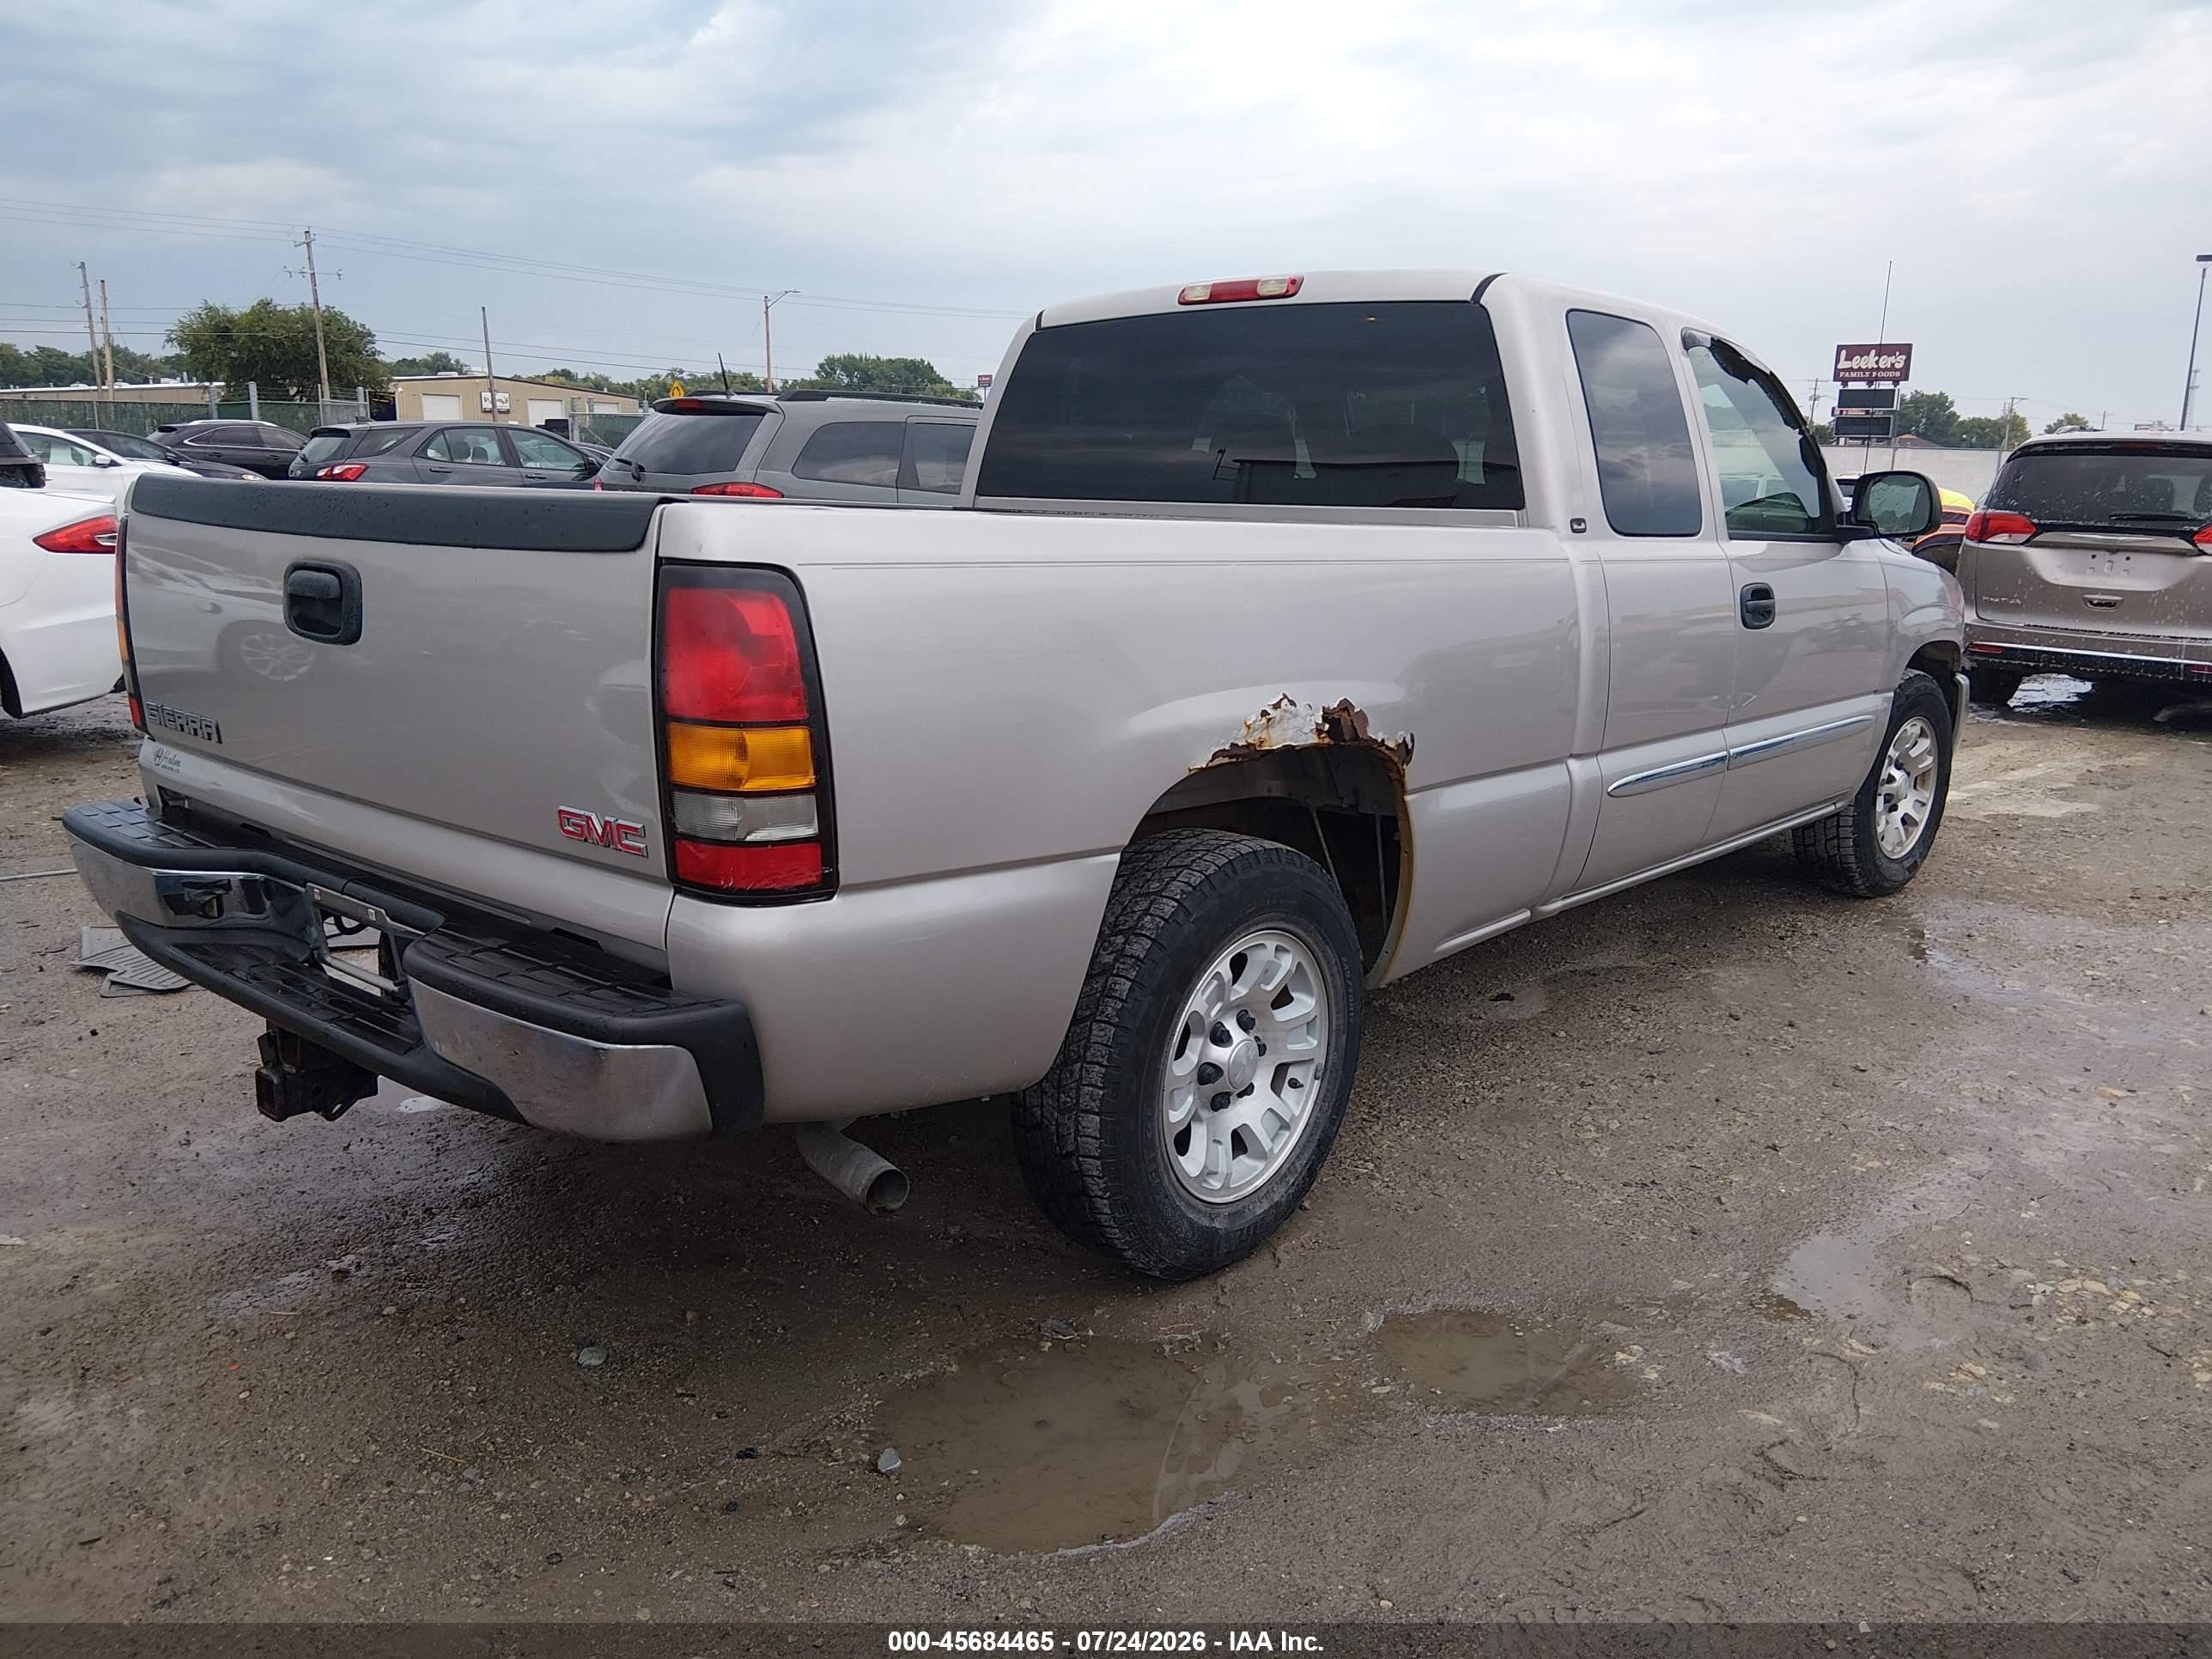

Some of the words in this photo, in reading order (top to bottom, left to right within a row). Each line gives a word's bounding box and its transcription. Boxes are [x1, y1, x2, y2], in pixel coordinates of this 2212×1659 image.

[1836, 349, 1906, 369] Leeker's
[145, 701, 223, 744] SIERRA
[557, 805, 649, 858] GMC
